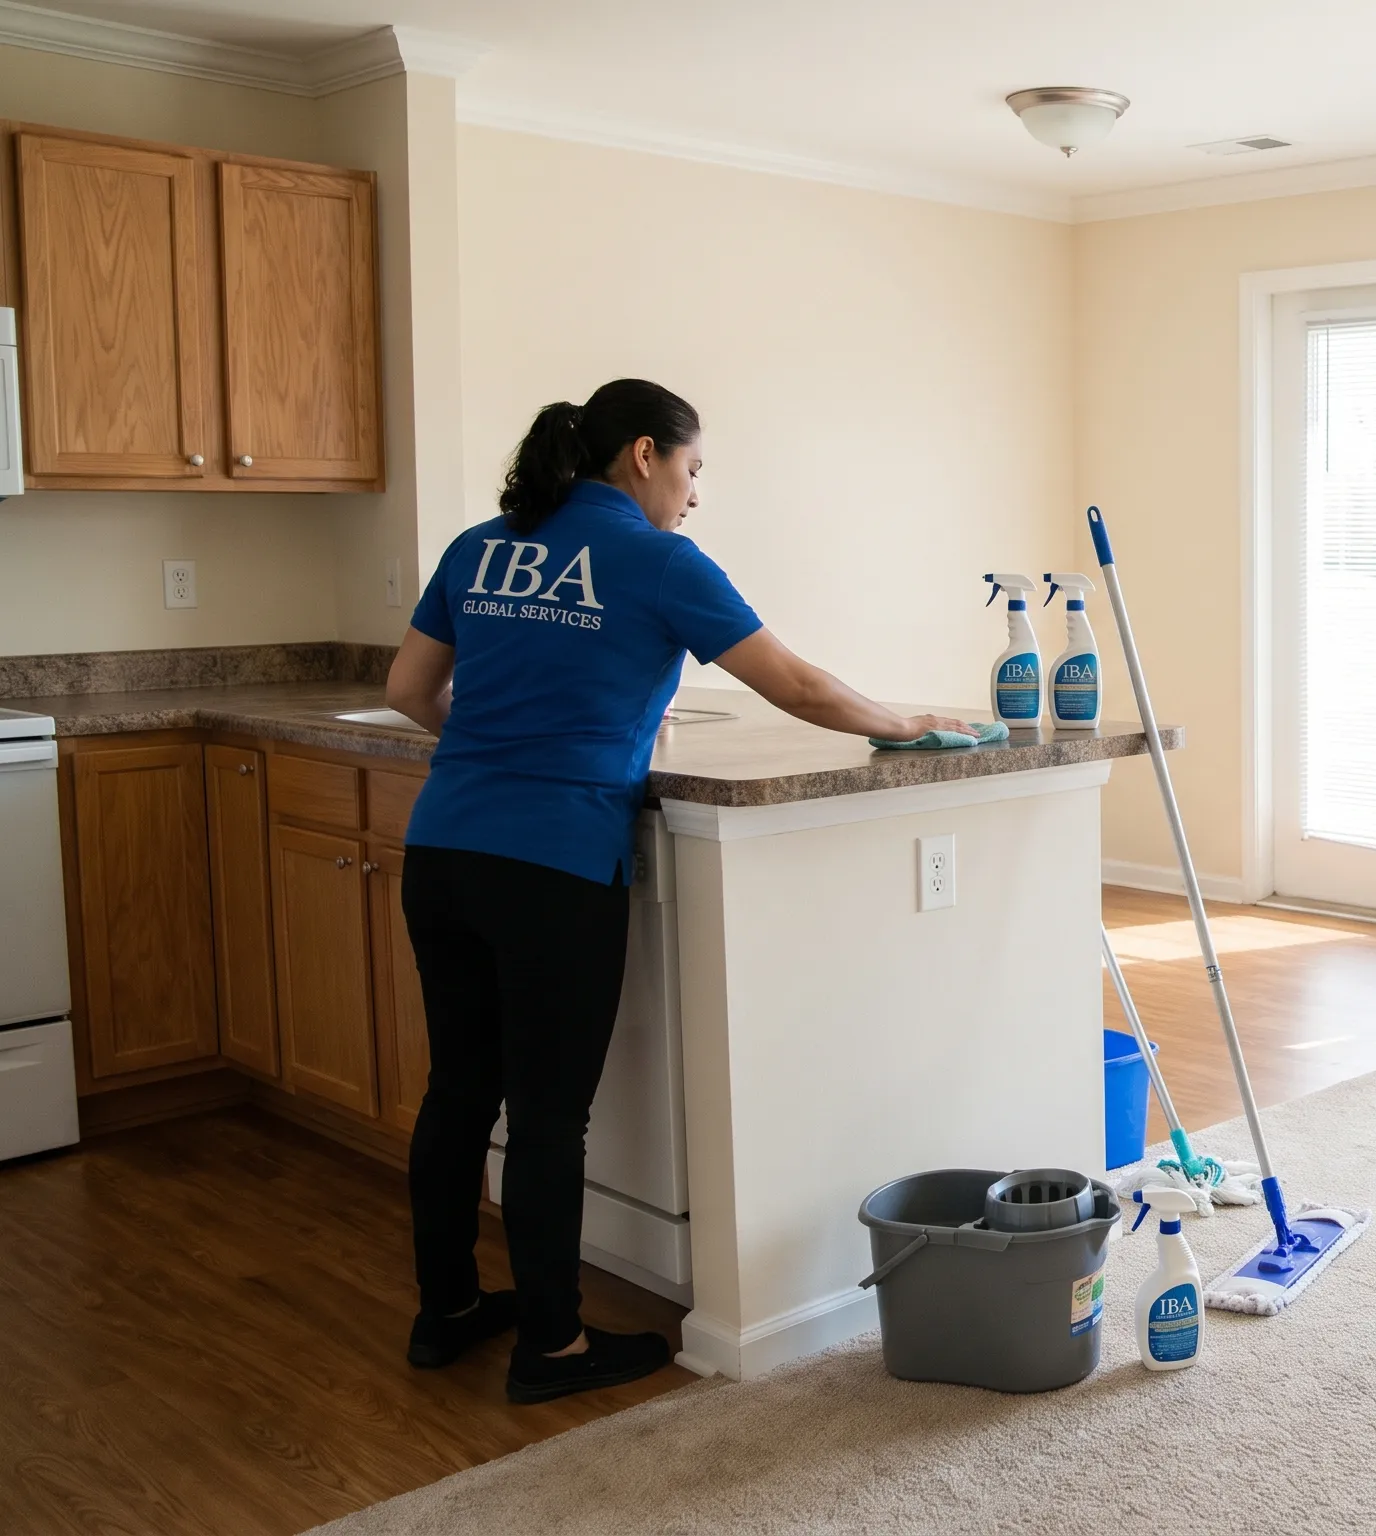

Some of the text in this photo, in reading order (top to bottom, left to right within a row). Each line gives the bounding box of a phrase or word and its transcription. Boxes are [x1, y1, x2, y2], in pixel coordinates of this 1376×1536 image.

[467, 539, 604, 610] IBA
[463, 600, 602, 630] GLOBAL SERVICES
[1005, 663, 1036, 678] IBA
[1062, 664, 1094, 678] IBA
[1160, 1296, 1193, 1315] IBA
